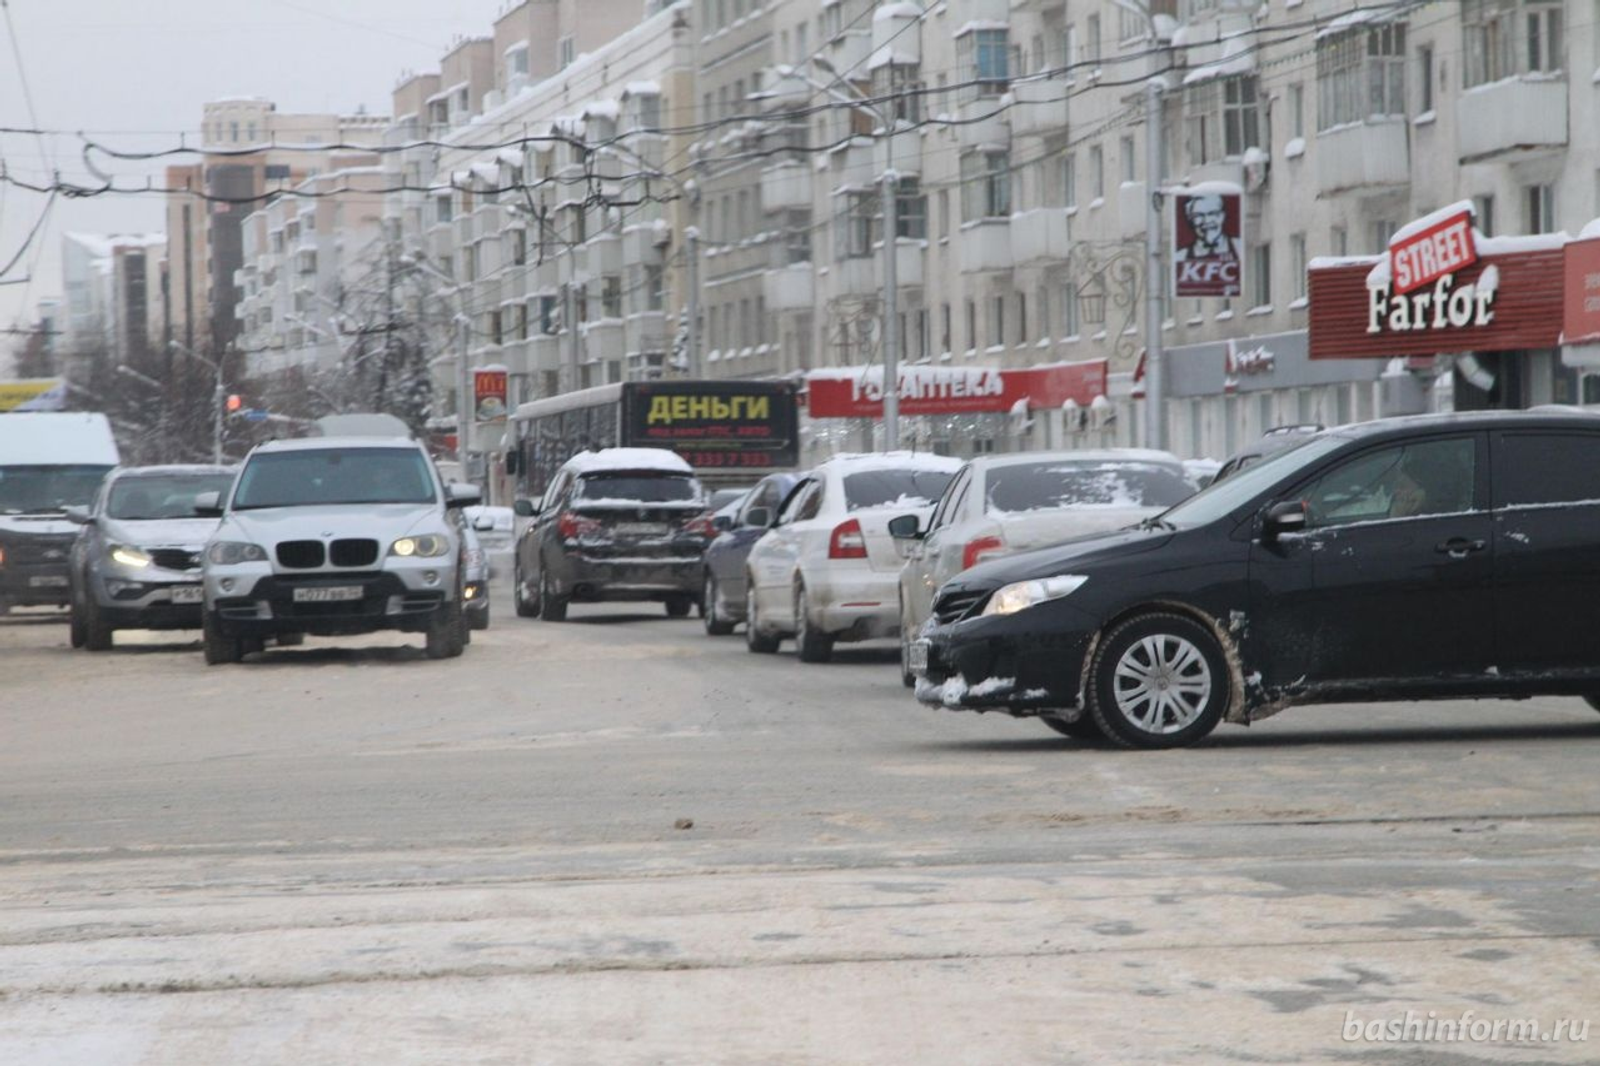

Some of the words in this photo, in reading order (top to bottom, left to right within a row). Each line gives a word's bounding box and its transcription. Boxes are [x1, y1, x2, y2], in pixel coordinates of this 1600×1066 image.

[1394, 221, 1469, 289] STREET
[1179, 261, 1238, 282] KFC
[1366, 273, 1495, 333] Farfor
[852, 371, 1004, 401] ГОАПТЕКА
[647, 396, 769, 424] ДЕНЬГИ
